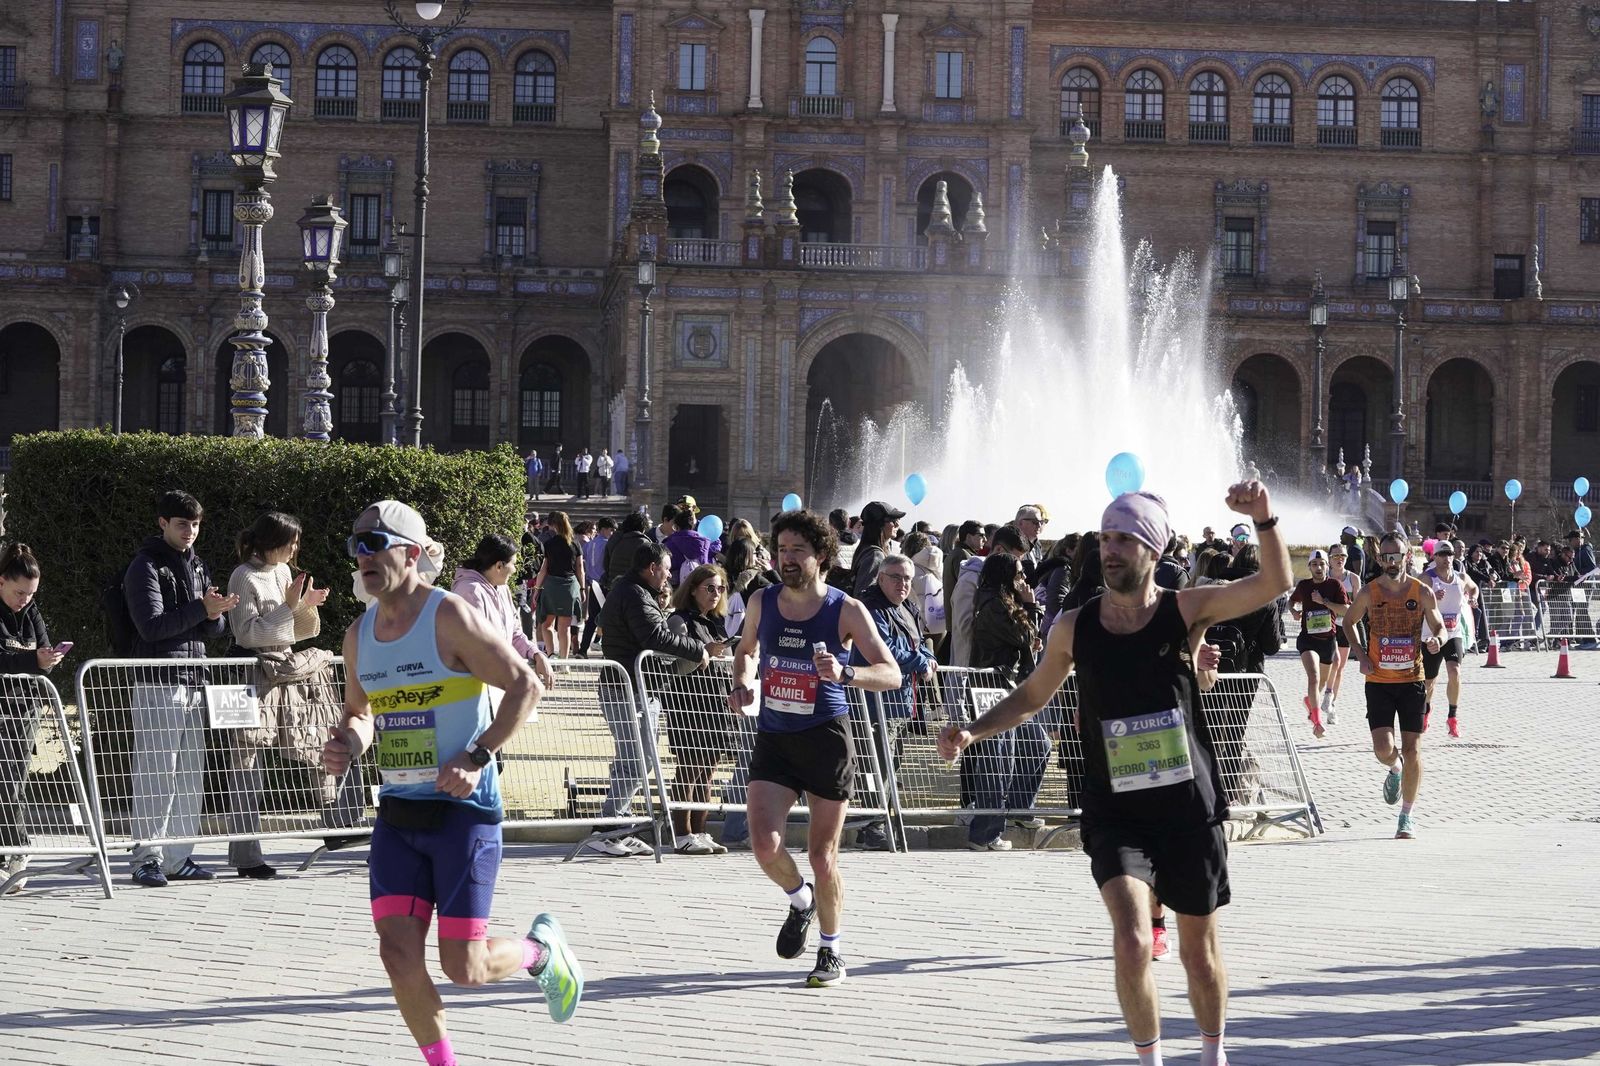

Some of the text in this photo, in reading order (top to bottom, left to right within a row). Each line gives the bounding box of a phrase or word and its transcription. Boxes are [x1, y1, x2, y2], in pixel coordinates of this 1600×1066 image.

[396, 662, 424, 673] CURVA
[781, 660, 813, 671] ZURICH
[780, 676, 797, 686] 1373
[770, 685, 807, 701] KAMIEL
[220, 691, 248, 709] AMS
[388, 716, 426, 727] ZURICH
[1132, 716, 1177, 731] ZURICH
[390, 738, 409, 748] 1676
[1137, 740, 1161, 752] 3363
[1112, 762, 1146, 777] PEDRO
